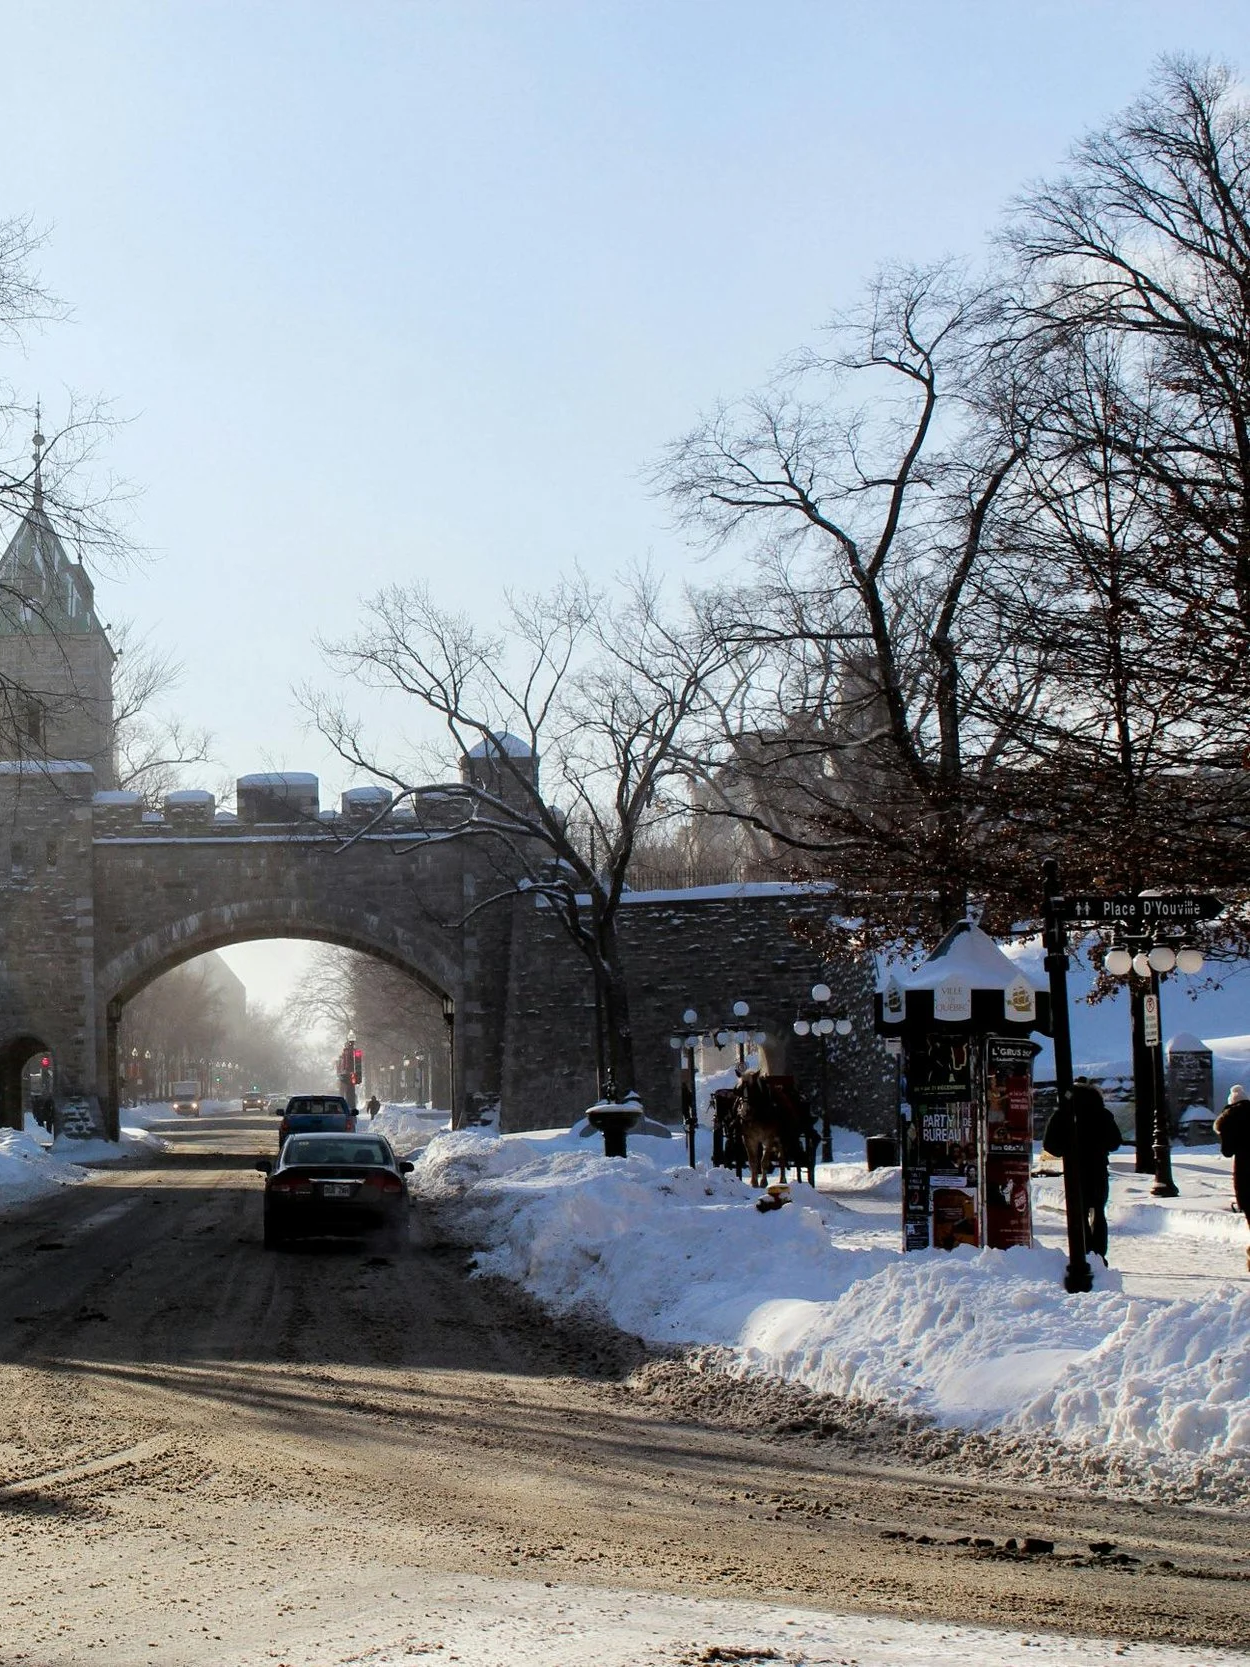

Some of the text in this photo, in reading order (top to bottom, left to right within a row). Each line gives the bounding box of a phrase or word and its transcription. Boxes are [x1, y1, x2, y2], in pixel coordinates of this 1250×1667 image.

[1103, 900, 1201, 916] Place D'Youville
[941, 986, 963, 995] VILLE
[923, 1113, 973, 1127] PARTY DE
[923, 1129, 961, 1142] BUREAU
